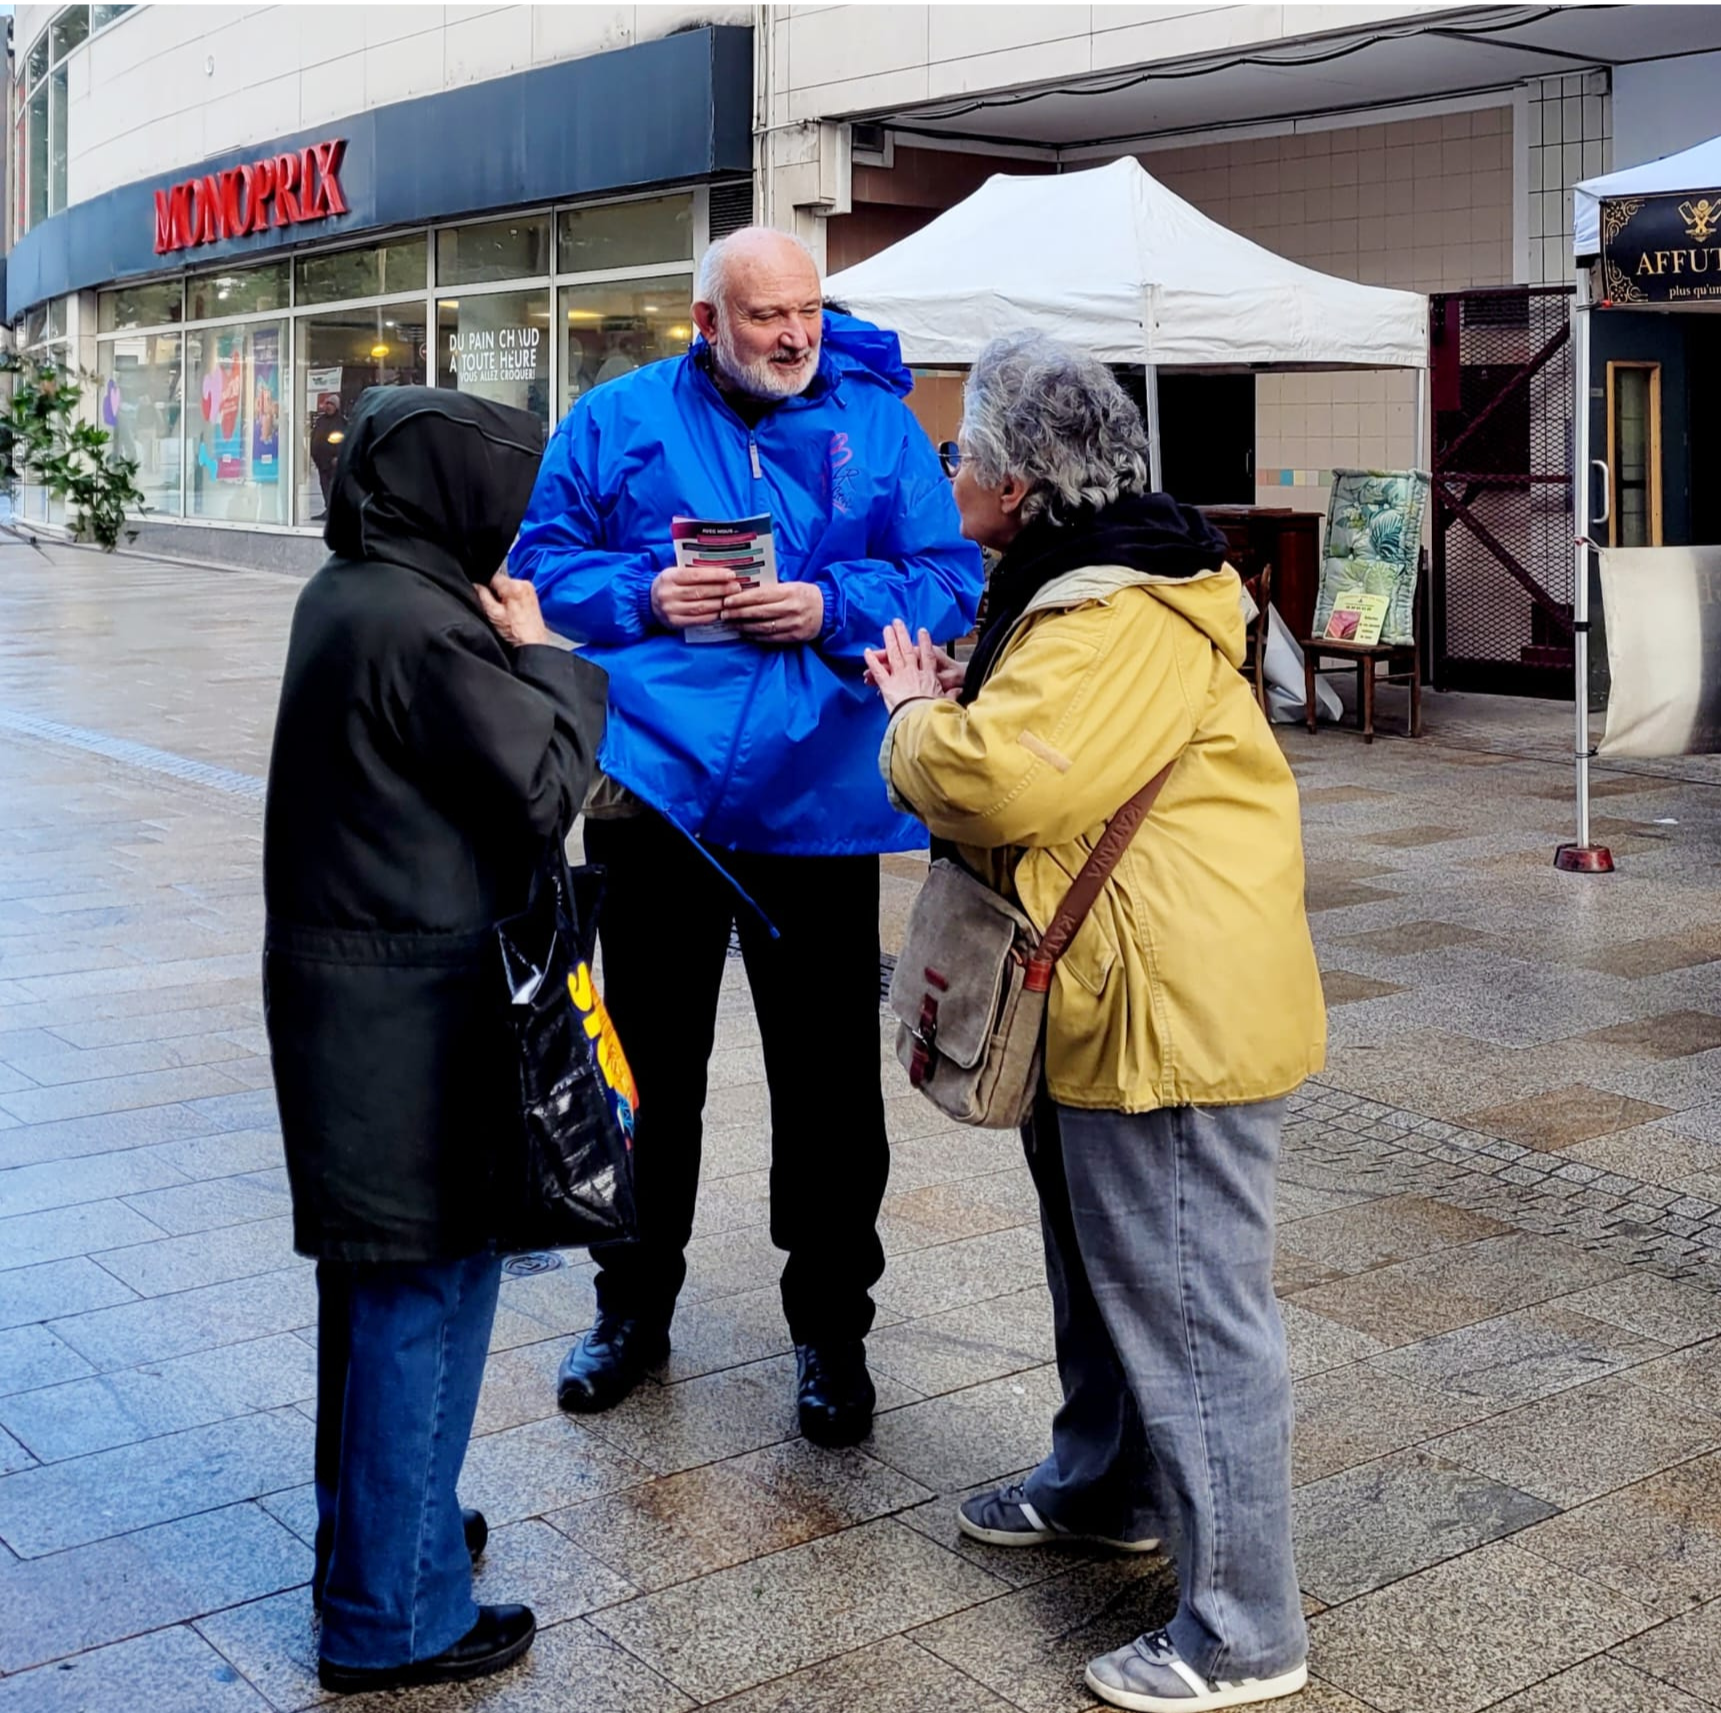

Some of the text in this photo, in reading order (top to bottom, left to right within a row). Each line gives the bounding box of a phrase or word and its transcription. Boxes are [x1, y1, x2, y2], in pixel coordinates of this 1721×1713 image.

[153, 138, 349, 254] MONOPRIX
[1669, 285, 1691, 299] plus
[449, 333, 464, 352] DU
[469, 331, 494, 350] PAIN
[462, 352, 495, 371] TOUTE
[460, 368, 536, 382] VOUS ALLEZ CROQUER!
